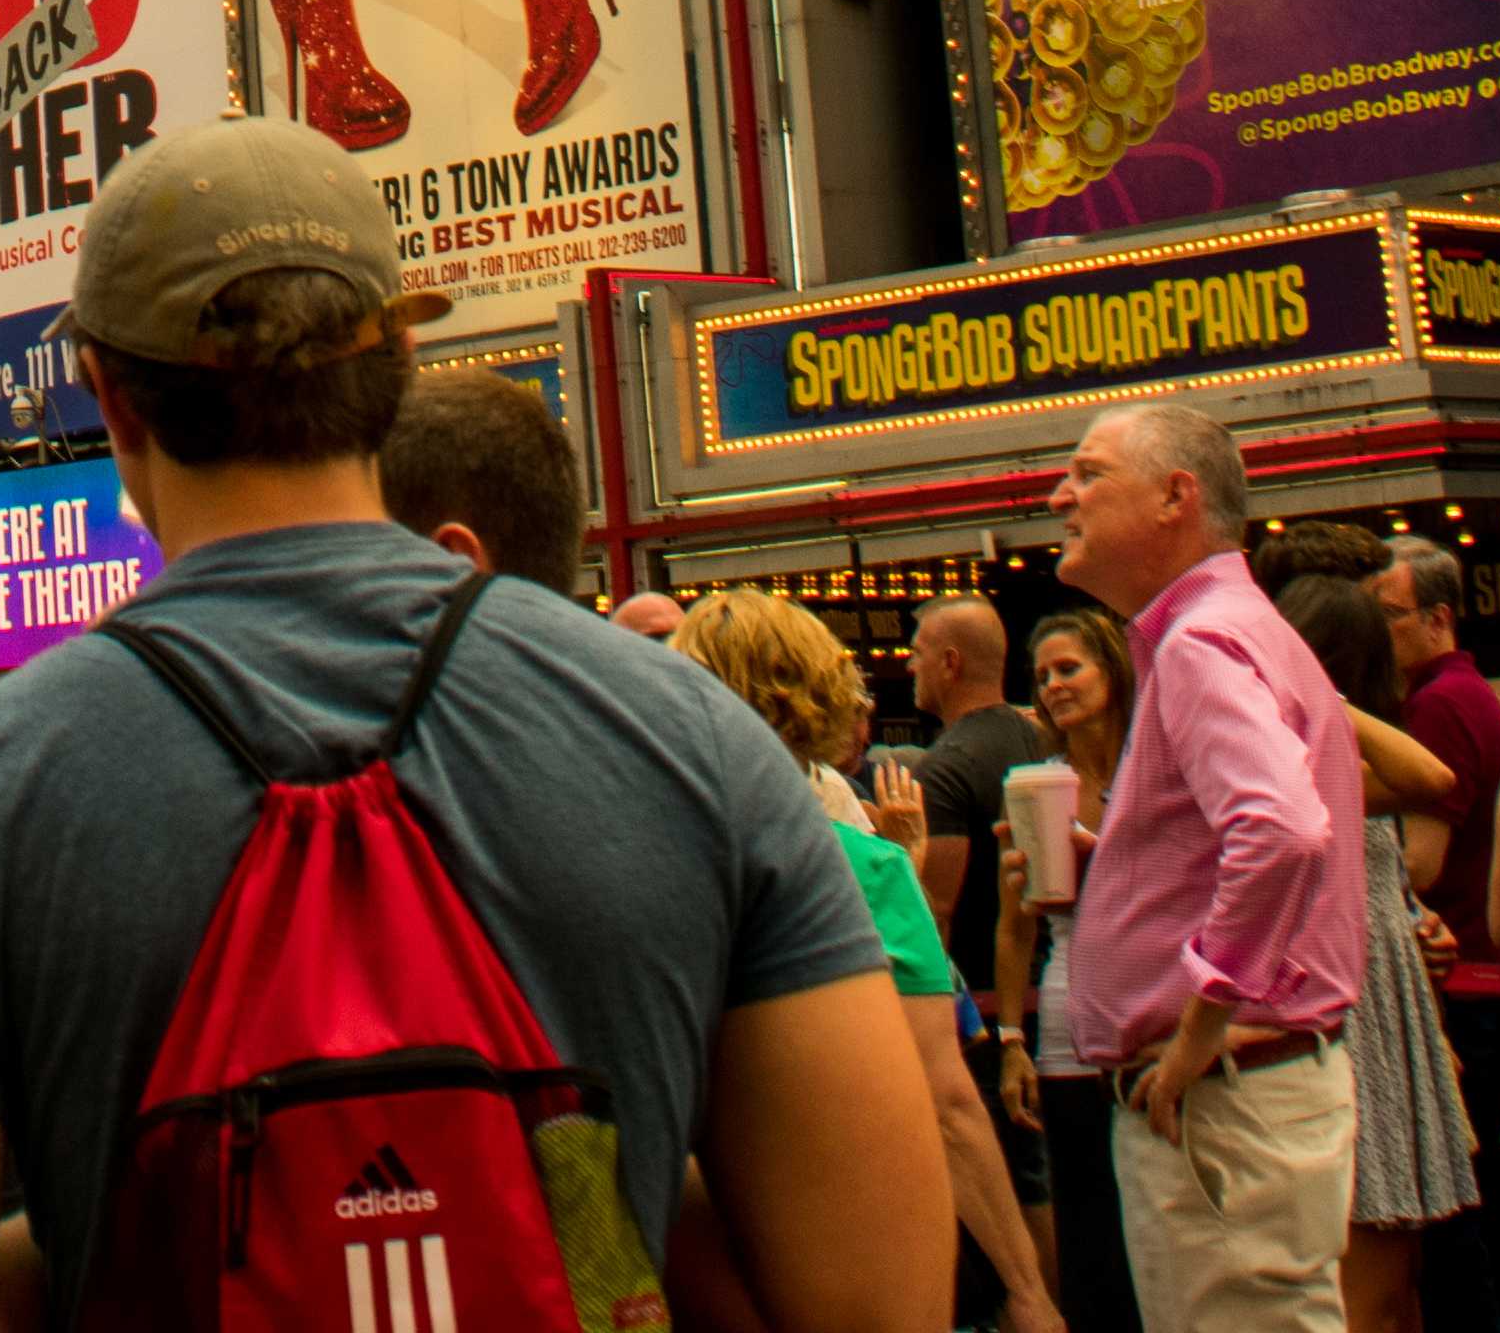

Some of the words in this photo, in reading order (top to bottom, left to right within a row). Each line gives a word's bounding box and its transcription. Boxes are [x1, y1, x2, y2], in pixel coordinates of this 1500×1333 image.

[1238, 82, 1472, 146] @SpongeBobBway
[420, 167, 441, 221] 6
[446, 150, 532, 215] TONY
[542, 122, 680, 200] AWARDS
[433, 213, 517, 255] BEST
[525, 184, 685, 240] MUSICAL
[402, 258, 470, 294] SICAL.COM
[480, 256, 506, 279] FOR
[508, 247, 561, 276] TICKETS
[563, 239, 595, 267] CALL
[597, 222, 688, 260] 212-239-6200
[25, 341, 54, 391] 111
[788, 317, 1016, 416] SPONGEBOB
[1020, 262, 1311, 378] SQUAREPANTS
[53, 497, 89, 559] AT
[17, 557, 142, 630] THEATRE
[334, 1184, 441, 1219] adidas
